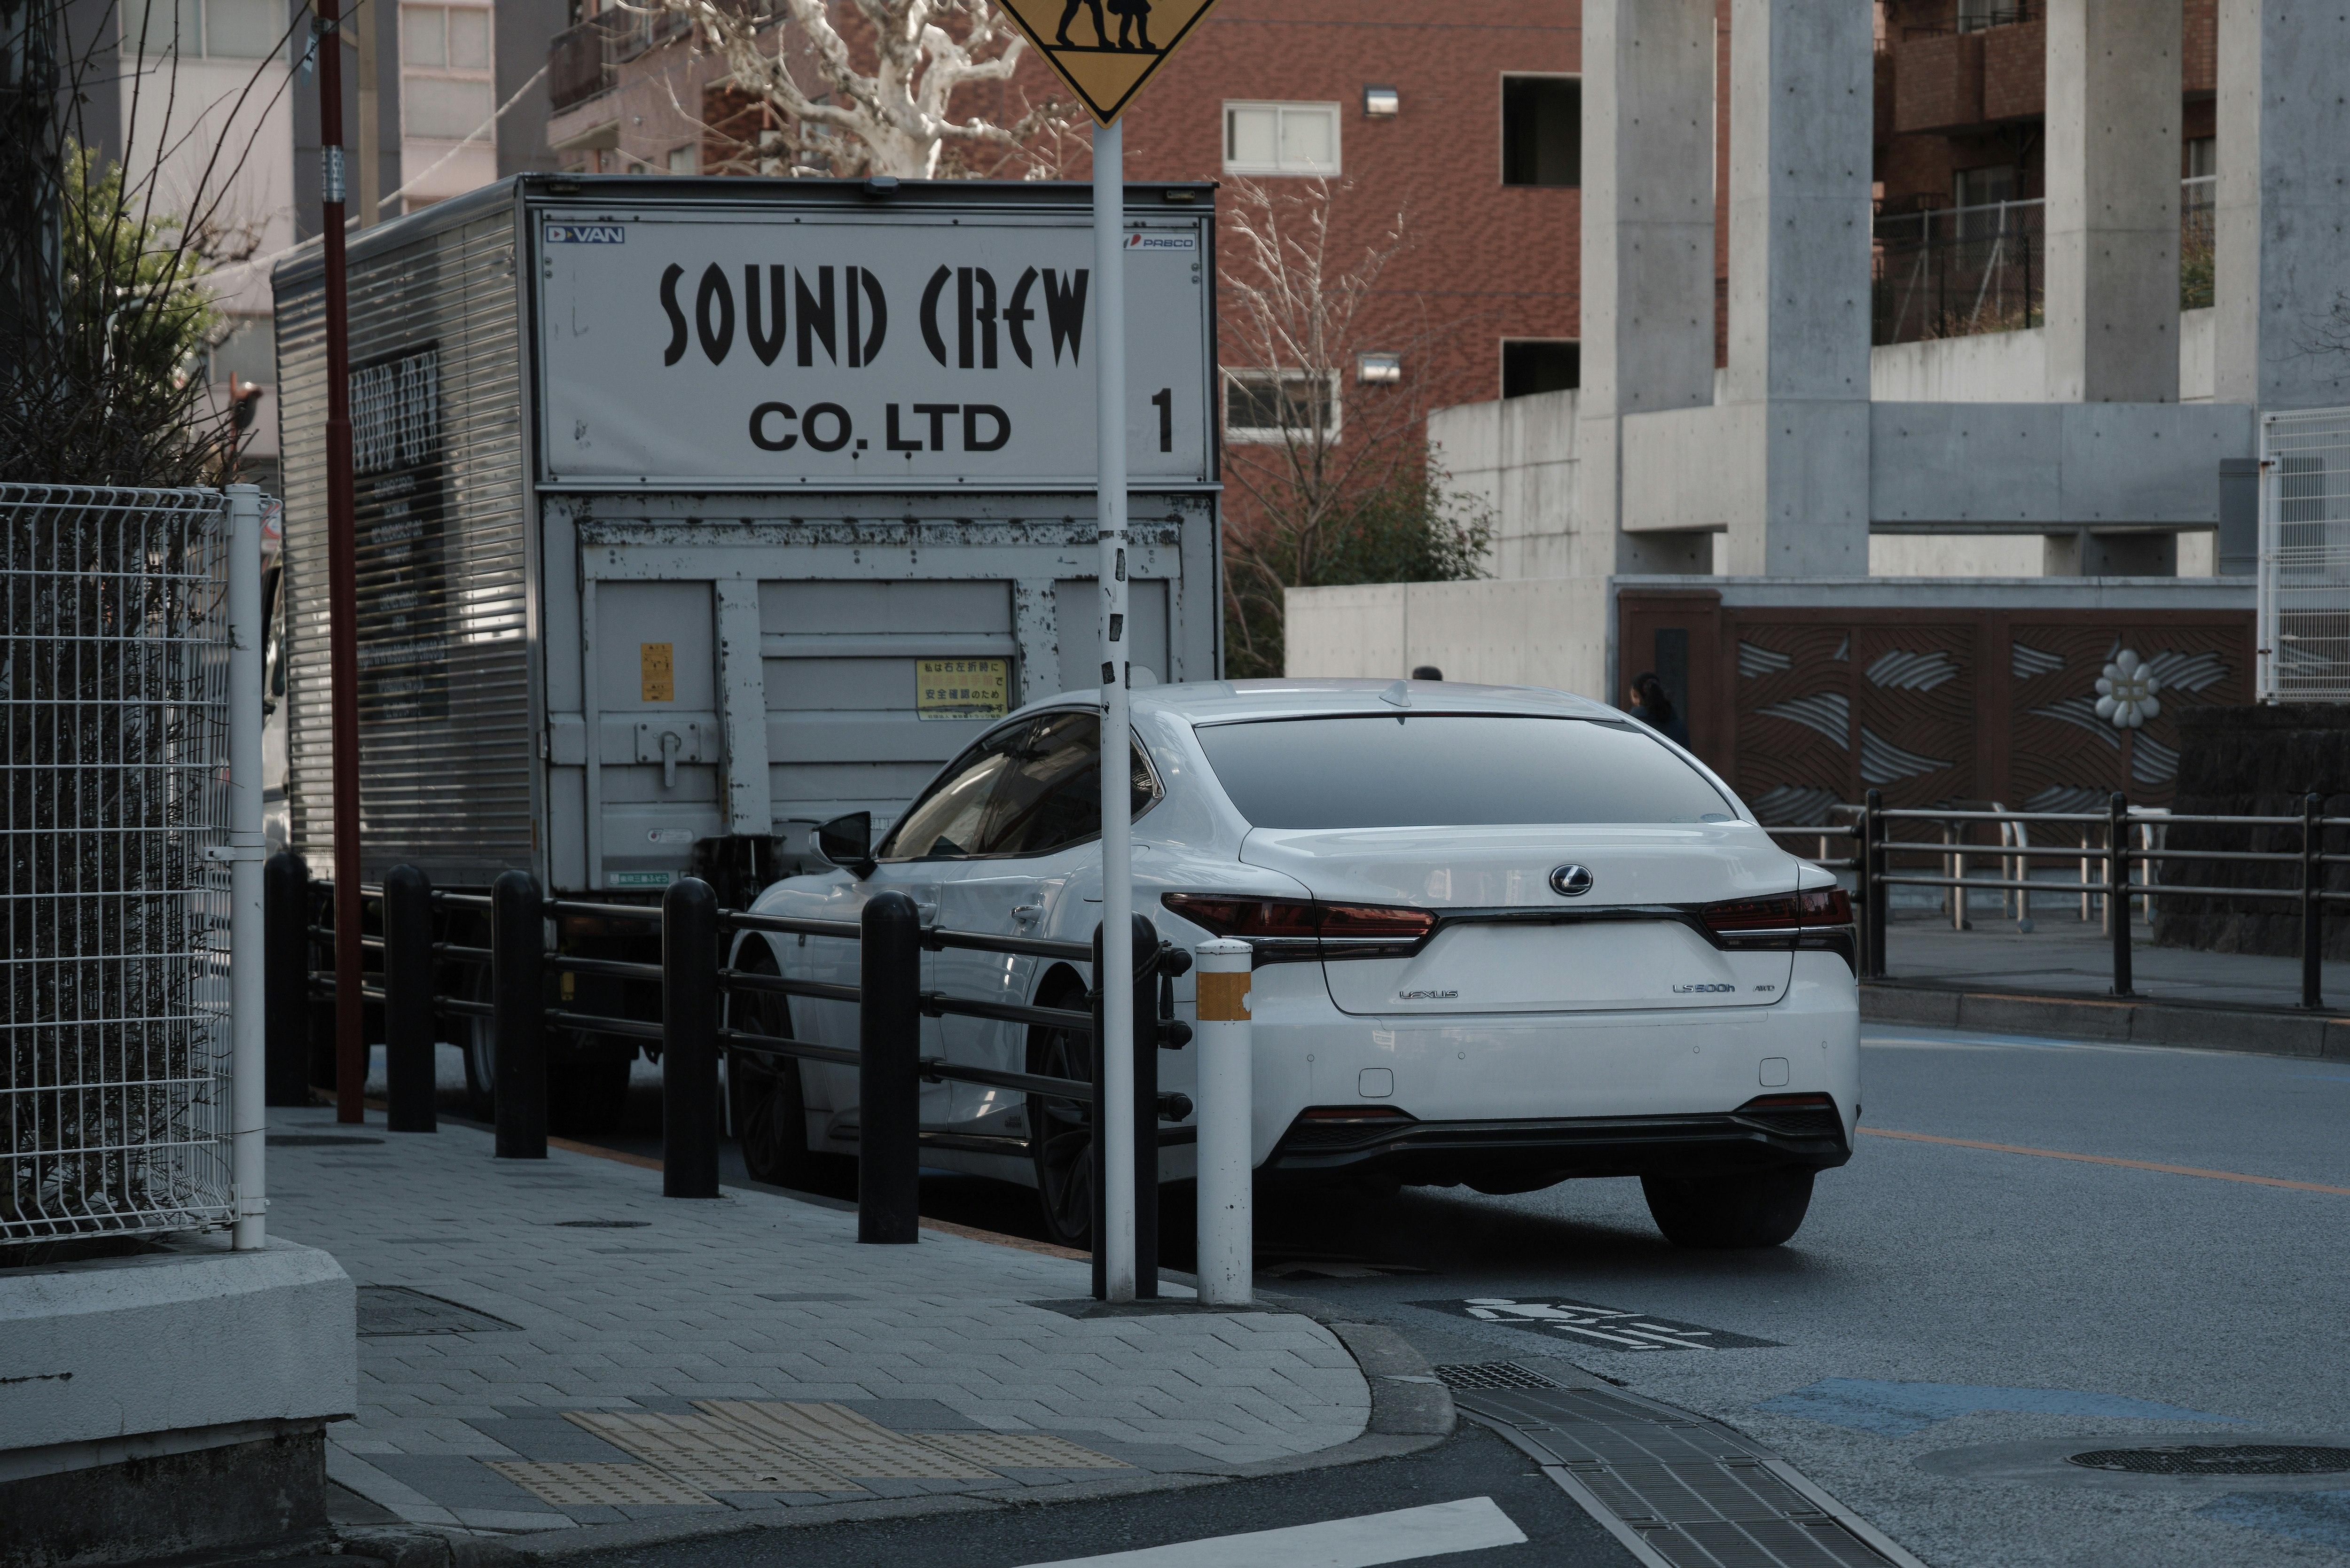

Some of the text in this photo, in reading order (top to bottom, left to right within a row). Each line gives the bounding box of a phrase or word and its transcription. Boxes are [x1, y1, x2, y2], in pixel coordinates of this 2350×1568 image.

[660, 261, 1089, 369] SOUND CREW
[1152, 388, 1172, 452] 1
[924, 662, 999, 672] 私は右左折時に
[925, 689, 999, 699] 安全確認のため
[1673, 983, 1735, 993] LS500h
[1400, 990, 1458, 999] LEXUS
